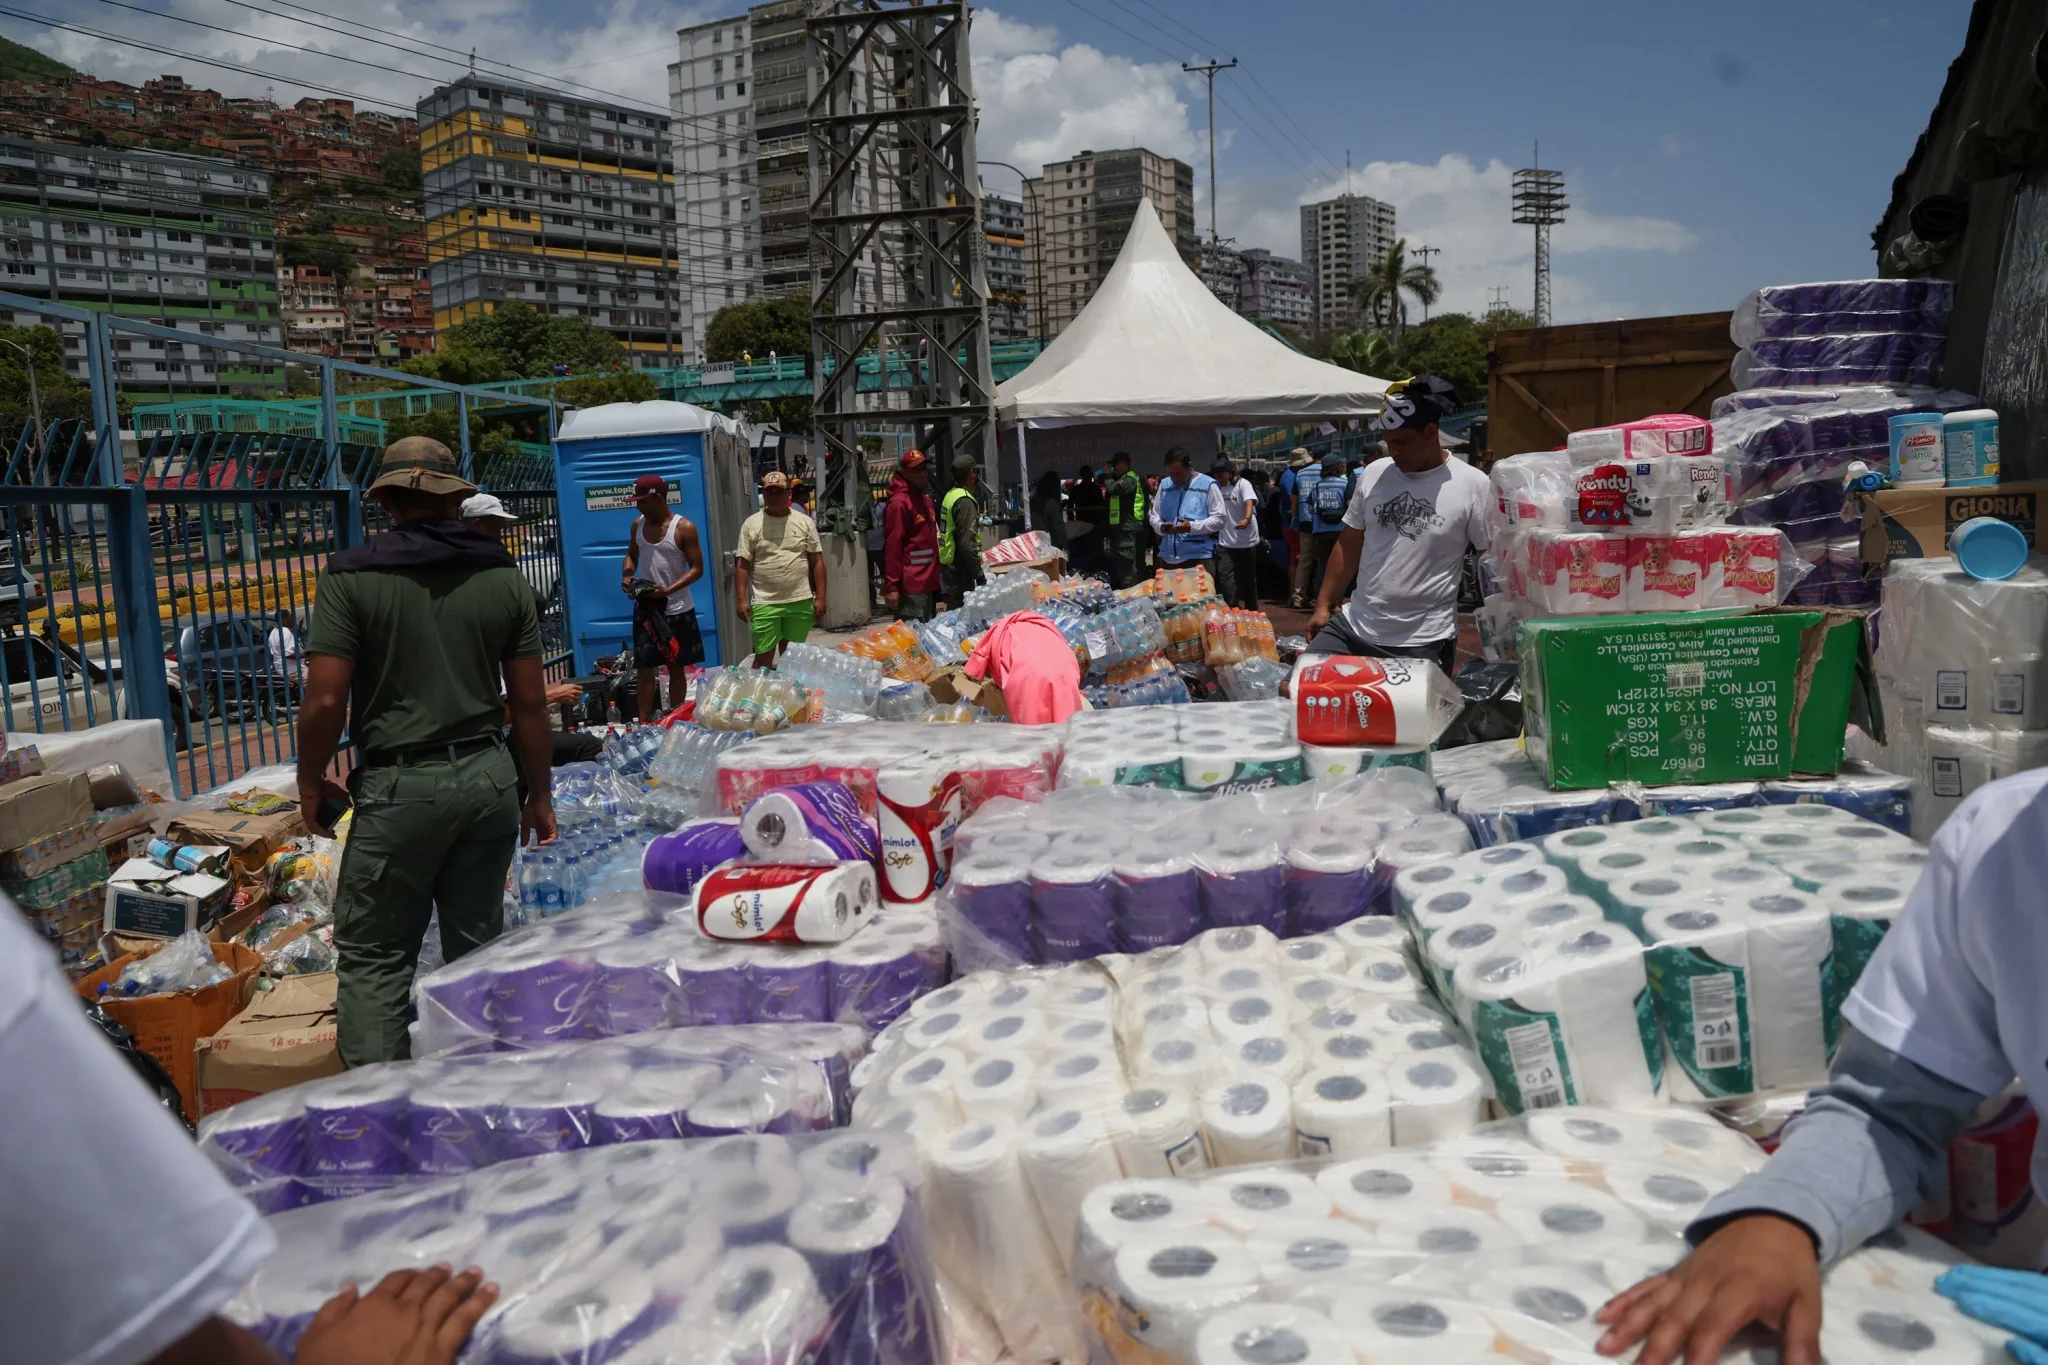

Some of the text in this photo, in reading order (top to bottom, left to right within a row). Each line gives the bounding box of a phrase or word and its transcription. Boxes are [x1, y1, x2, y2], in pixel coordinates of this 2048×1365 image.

[701, 364, 734, 373] SUAREZ
[1690, 466, 1719, 483] Rendy
[1950, 496, 2031, 520] GLORIA
[1569, 575, 1620, 592] Maple
[1645, 573, 1695, 590] Maple
[1724, 571, 1775, 587] Maple
[1603, 625, 1773, 644] Brickell Miami Florida 33131 U.S.A.
[1597, 634, 1780, 655] Distributed by Alive Cosmetics LLC
[1618, 647, 1759, 663] Alive Cosmetics LLC (USA)
[1711, 657, 1759, 666] Fabricado
[1633, 664, 1645, 673] de
[1704, 669, 1732, 679] MAD
[1746, 681, 1776, 692] LOT
[1352, 690, 1369, 728] Caricias
[1606, 695, 1776, 715] MEAS: 38 X 34 X 21CM
[1627, 716, 1658, 728] KGS
[1680, 714, 1707, 725] 11.5
[1629, 731, 1659, 743] KGS
[1685, 728, 1705, 739] 9.6
[1630, 746, 1659, 757] PCS
[1689, 743, 1706, 753] 96
[1744, 754, 1778, 765] ITEM
[883, 837, 916, 848] mimlot
[885, 851, 913, 869] Soft
[731, 894, 748, 930] Soft
[753, 893, 764, 932] mimlot
